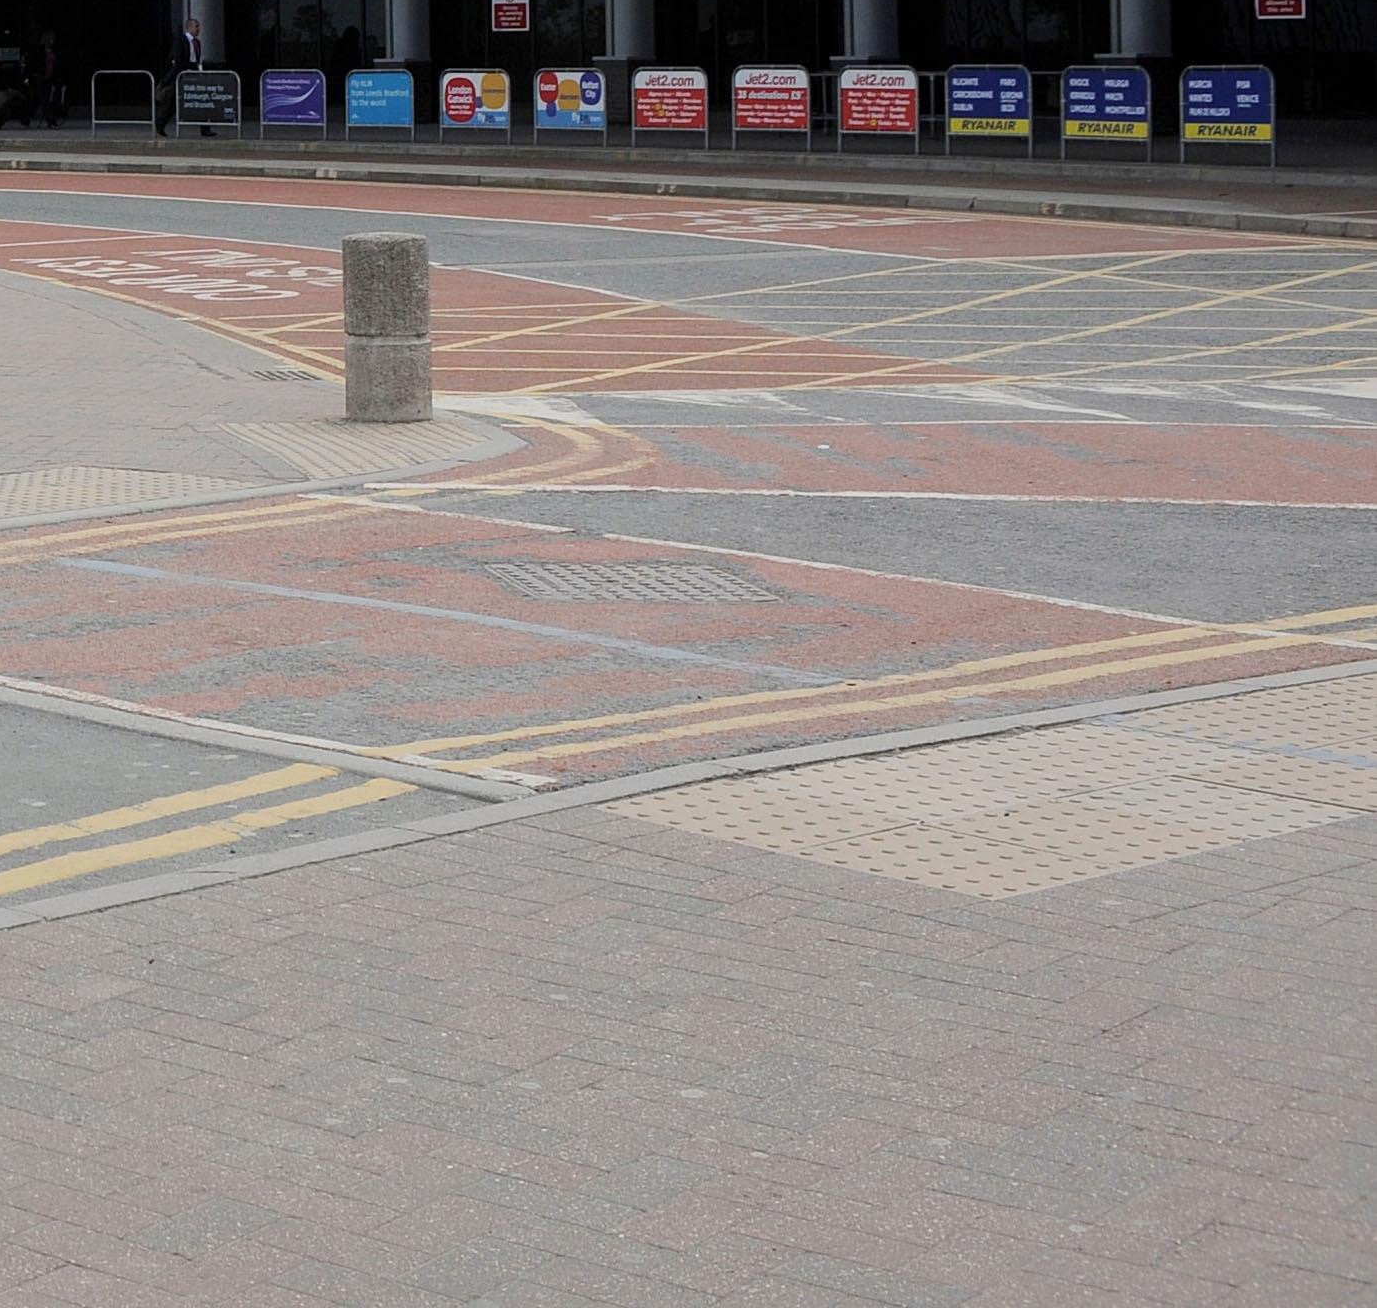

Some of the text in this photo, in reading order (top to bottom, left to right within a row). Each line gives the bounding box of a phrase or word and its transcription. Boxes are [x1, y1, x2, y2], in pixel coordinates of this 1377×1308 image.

[961, 119, 1017, 131] RYANAIR
[1077, 122, 1135, 134] RYANAIR
[1197, 124, 1257, 137] RYANAIR
[129, 248, 301, 269] ONLY
[8, 255, 302, 302] COURTESY
